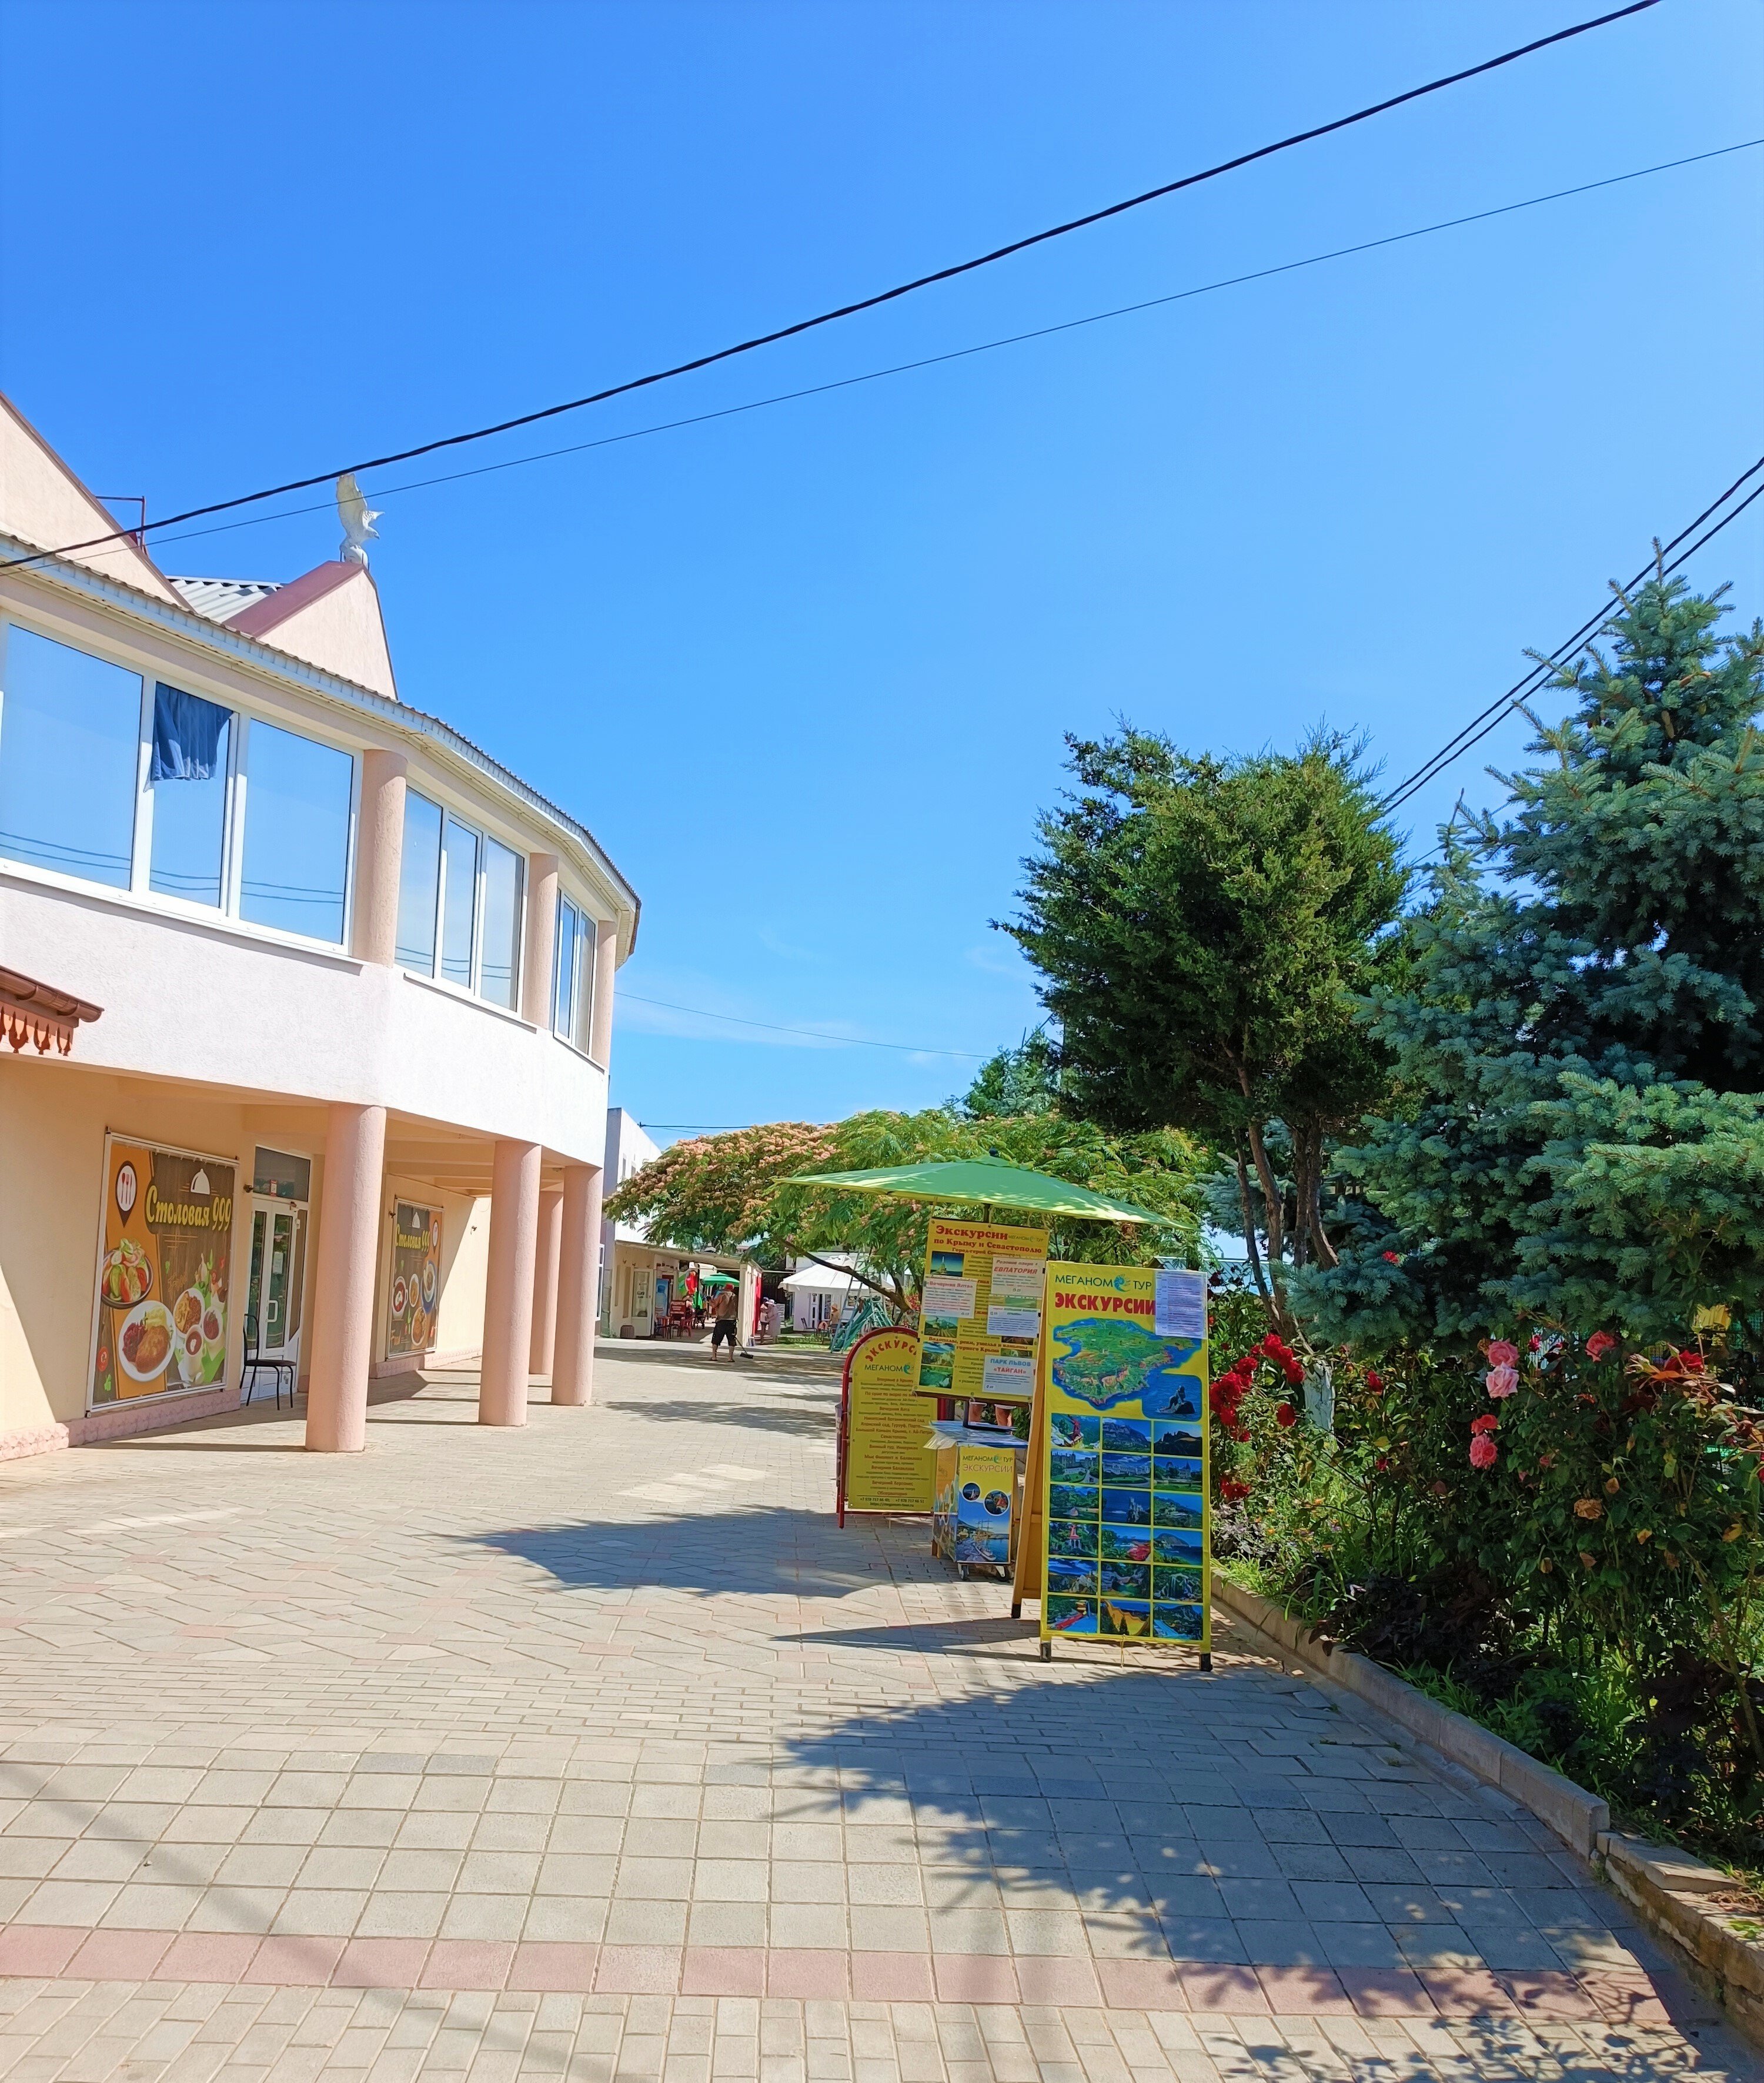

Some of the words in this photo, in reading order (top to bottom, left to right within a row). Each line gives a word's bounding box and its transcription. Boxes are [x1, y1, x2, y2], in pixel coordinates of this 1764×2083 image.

[146, 1185, 209, 1226] Столовая
[212, 1196, 231, 1231] 999
[395, 1223, 421, 1249] Столовая
[936, 1225, 1008, 1241] Экскурсии
[947, 1238, 976, 1248] Крыму
[987, 1242, 1042, 1253] Севастополю
[1055, 1275, 1113, 1287] МЕГАНОМ
[1133, 1280, 1152, 1290] ТУР
[1055, 1292, 1155, 1315] ЭКСКУРСИИ
[963, 1464, 1013, 1472] ЭКСКУРСИИ
